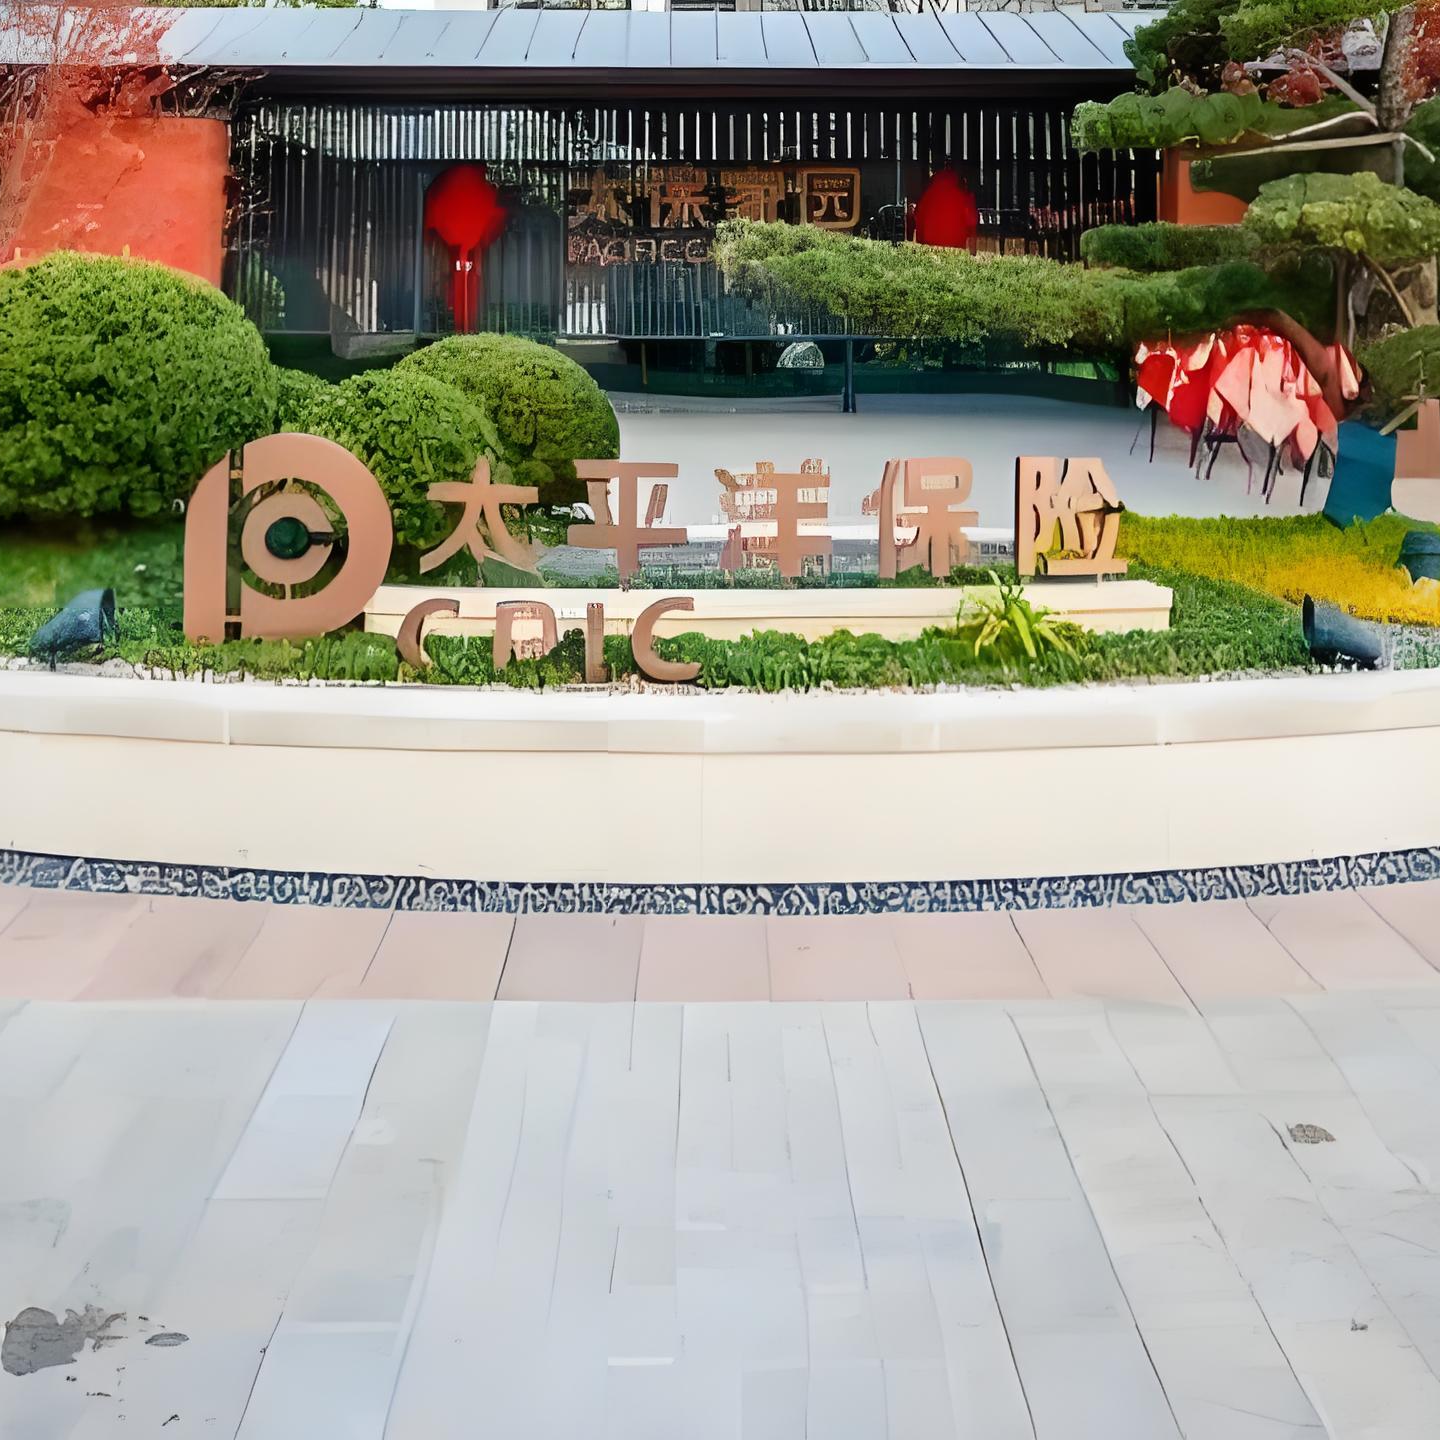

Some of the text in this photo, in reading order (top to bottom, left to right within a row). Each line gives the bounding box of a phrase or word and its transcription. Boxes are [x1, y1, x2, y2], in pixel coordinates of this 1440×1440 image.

[419, 456, 1129, 586] 太平洋保险
[397, 597, 702, 682] CPIC
